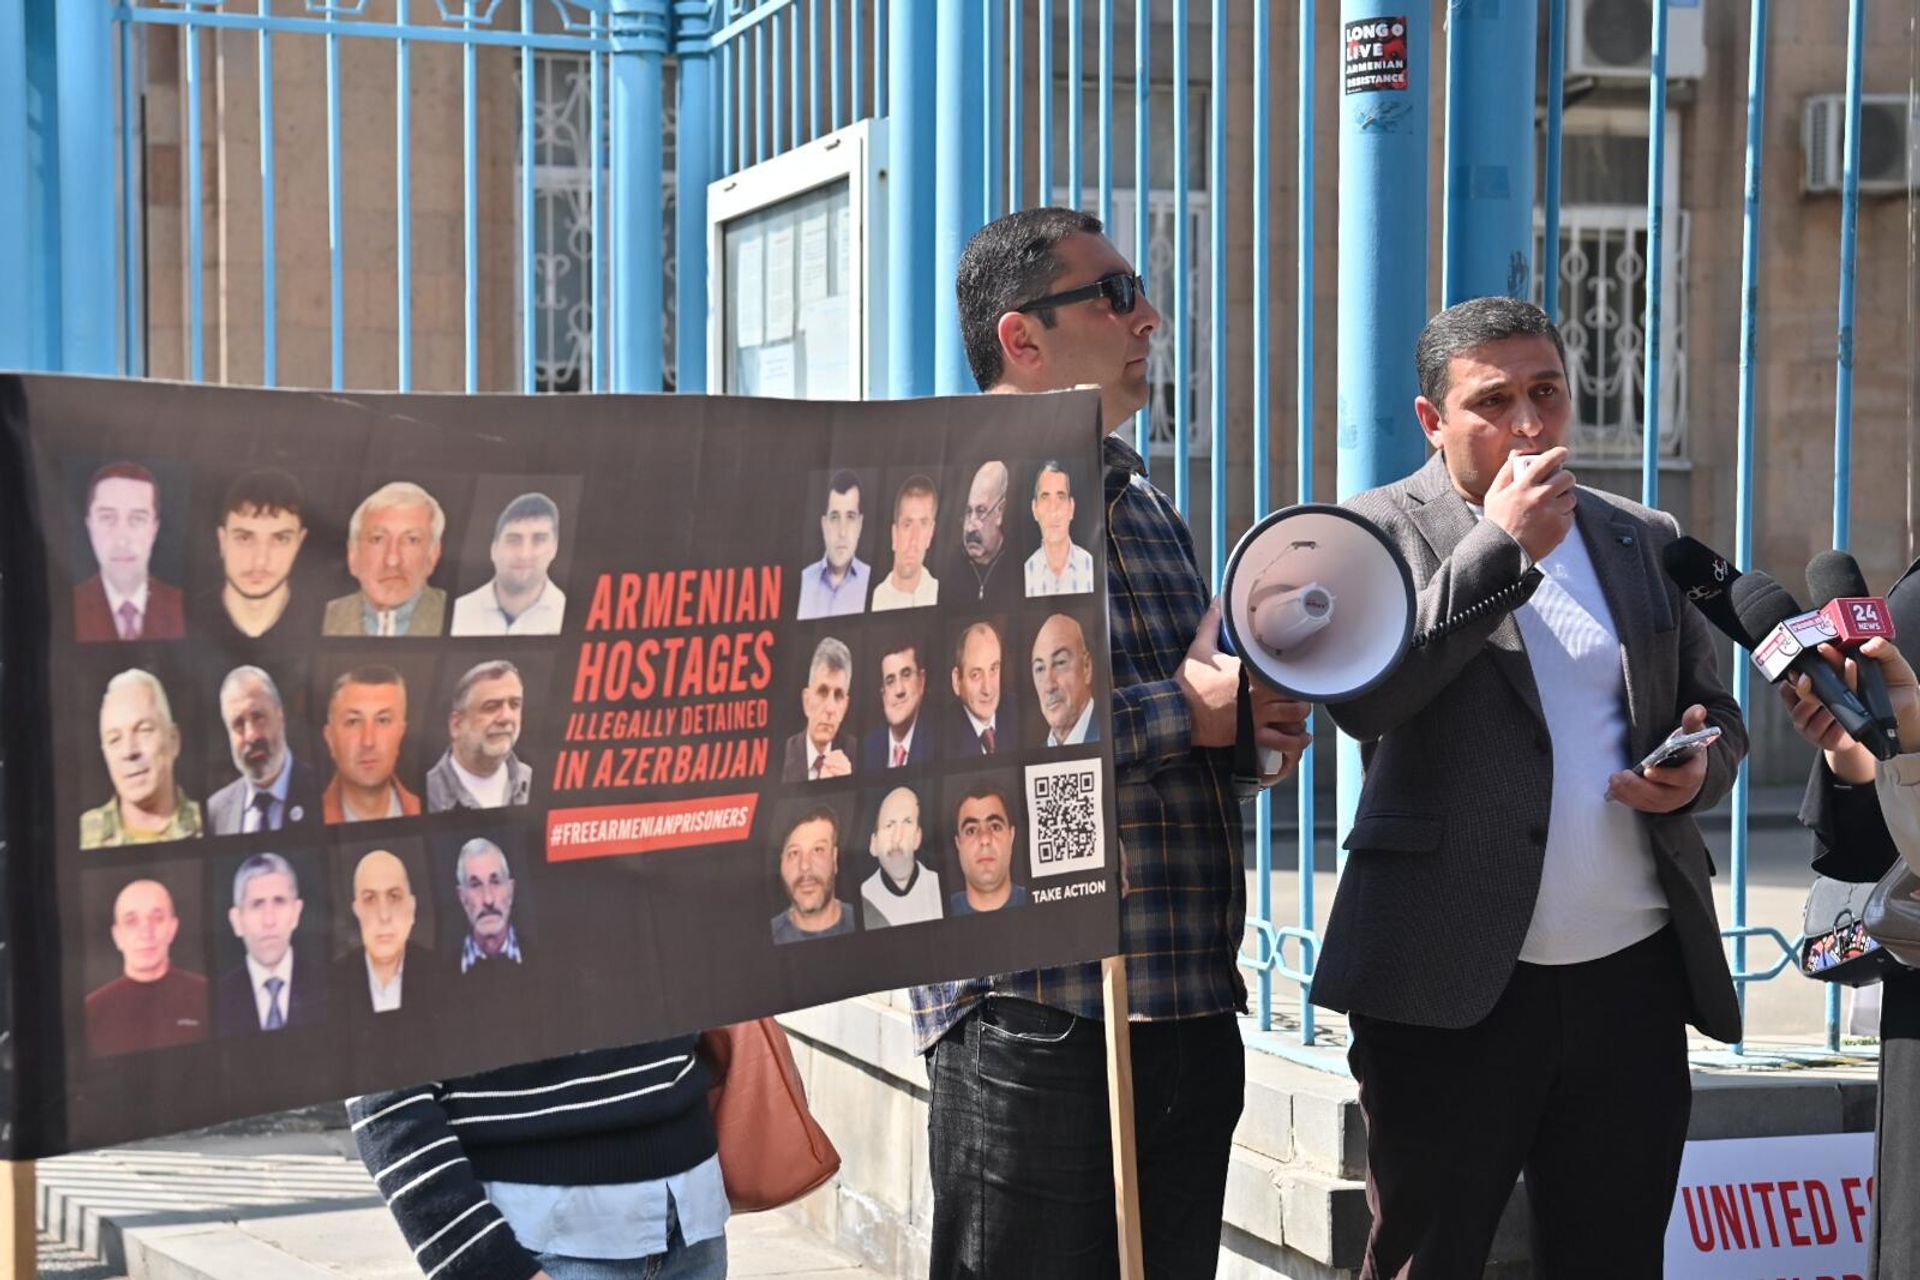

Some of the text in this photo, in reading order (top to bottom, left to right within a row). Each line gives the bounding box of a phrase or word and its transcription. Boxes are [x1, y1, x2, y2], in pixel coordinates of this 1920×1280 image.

[1346, 23, 1389, 42] LONG
[1346, 43, 1383, 61] LIVE
[1346, 60, 1404, 74] ARMENIAN
[1346, 73, 1405, 88] RESISTANCE
[585, 565, 782, 632] ARMENIAN
[1853, 604, 1878, 621] 24
[1857, 622, 1881, 630] NEWS
[572, 630, 774, 703] HOSTAGES
[565, 698, 768, 742] ILLEGALLY DETAINED
[553, 737, 768, 791] IN AZERBAIJAN
[550, 806, 749, 846] #FREEARMENIANPRISONERS
[1032, 879, 1106, 904] TAKE ACTION
[1681, 1179, 1838, 1253] UNITED
